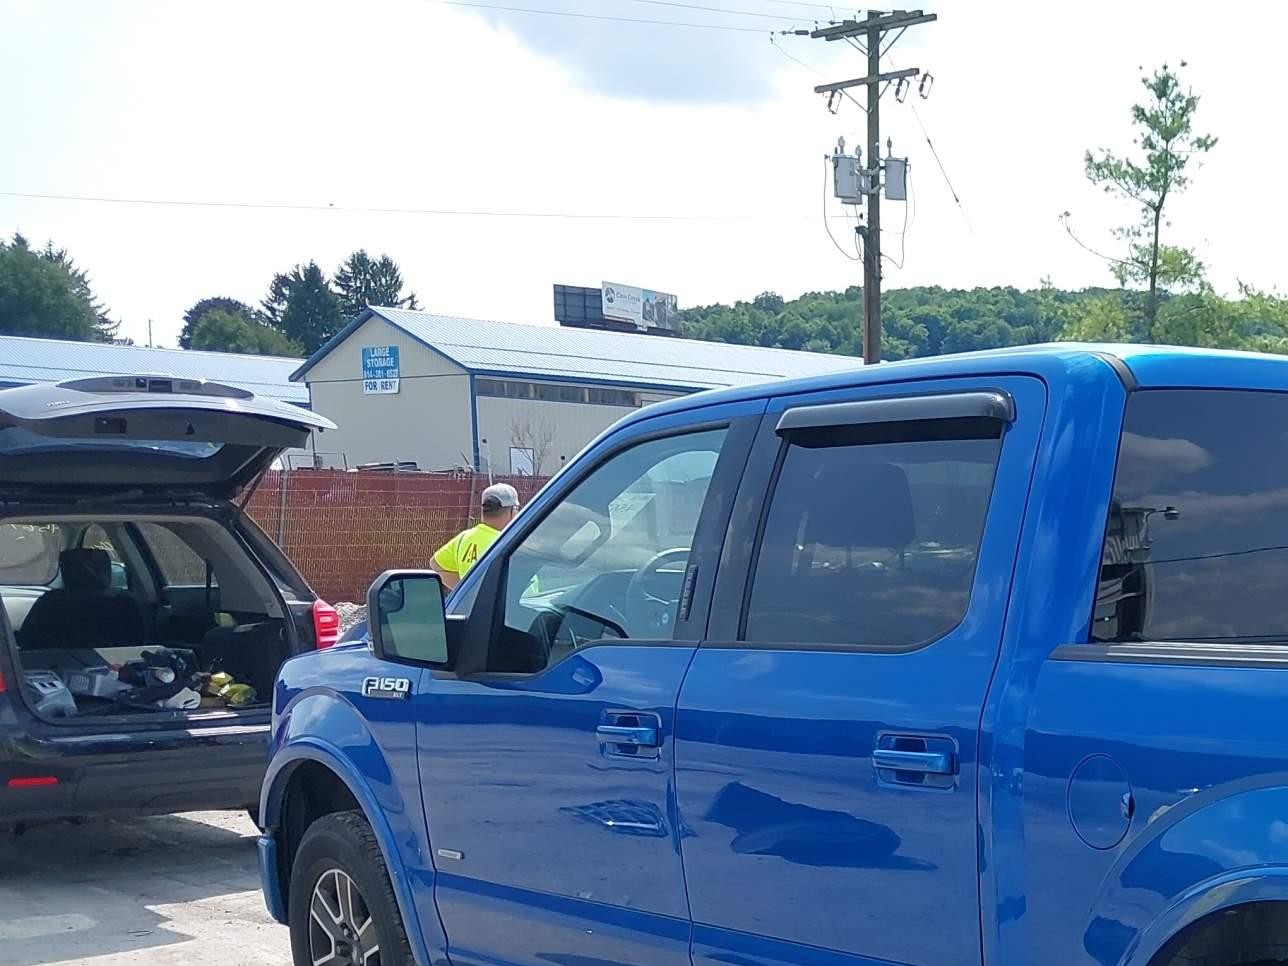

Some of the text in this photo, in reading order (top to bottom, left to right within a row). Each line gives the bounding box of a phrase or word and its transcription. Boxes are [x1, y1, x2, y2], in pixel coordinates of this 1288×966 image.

[370, 347, 389, 357] LARGE
[366, 357, 394, 367] STORAGE
[365, 380, 396, 390] FOR RENT
